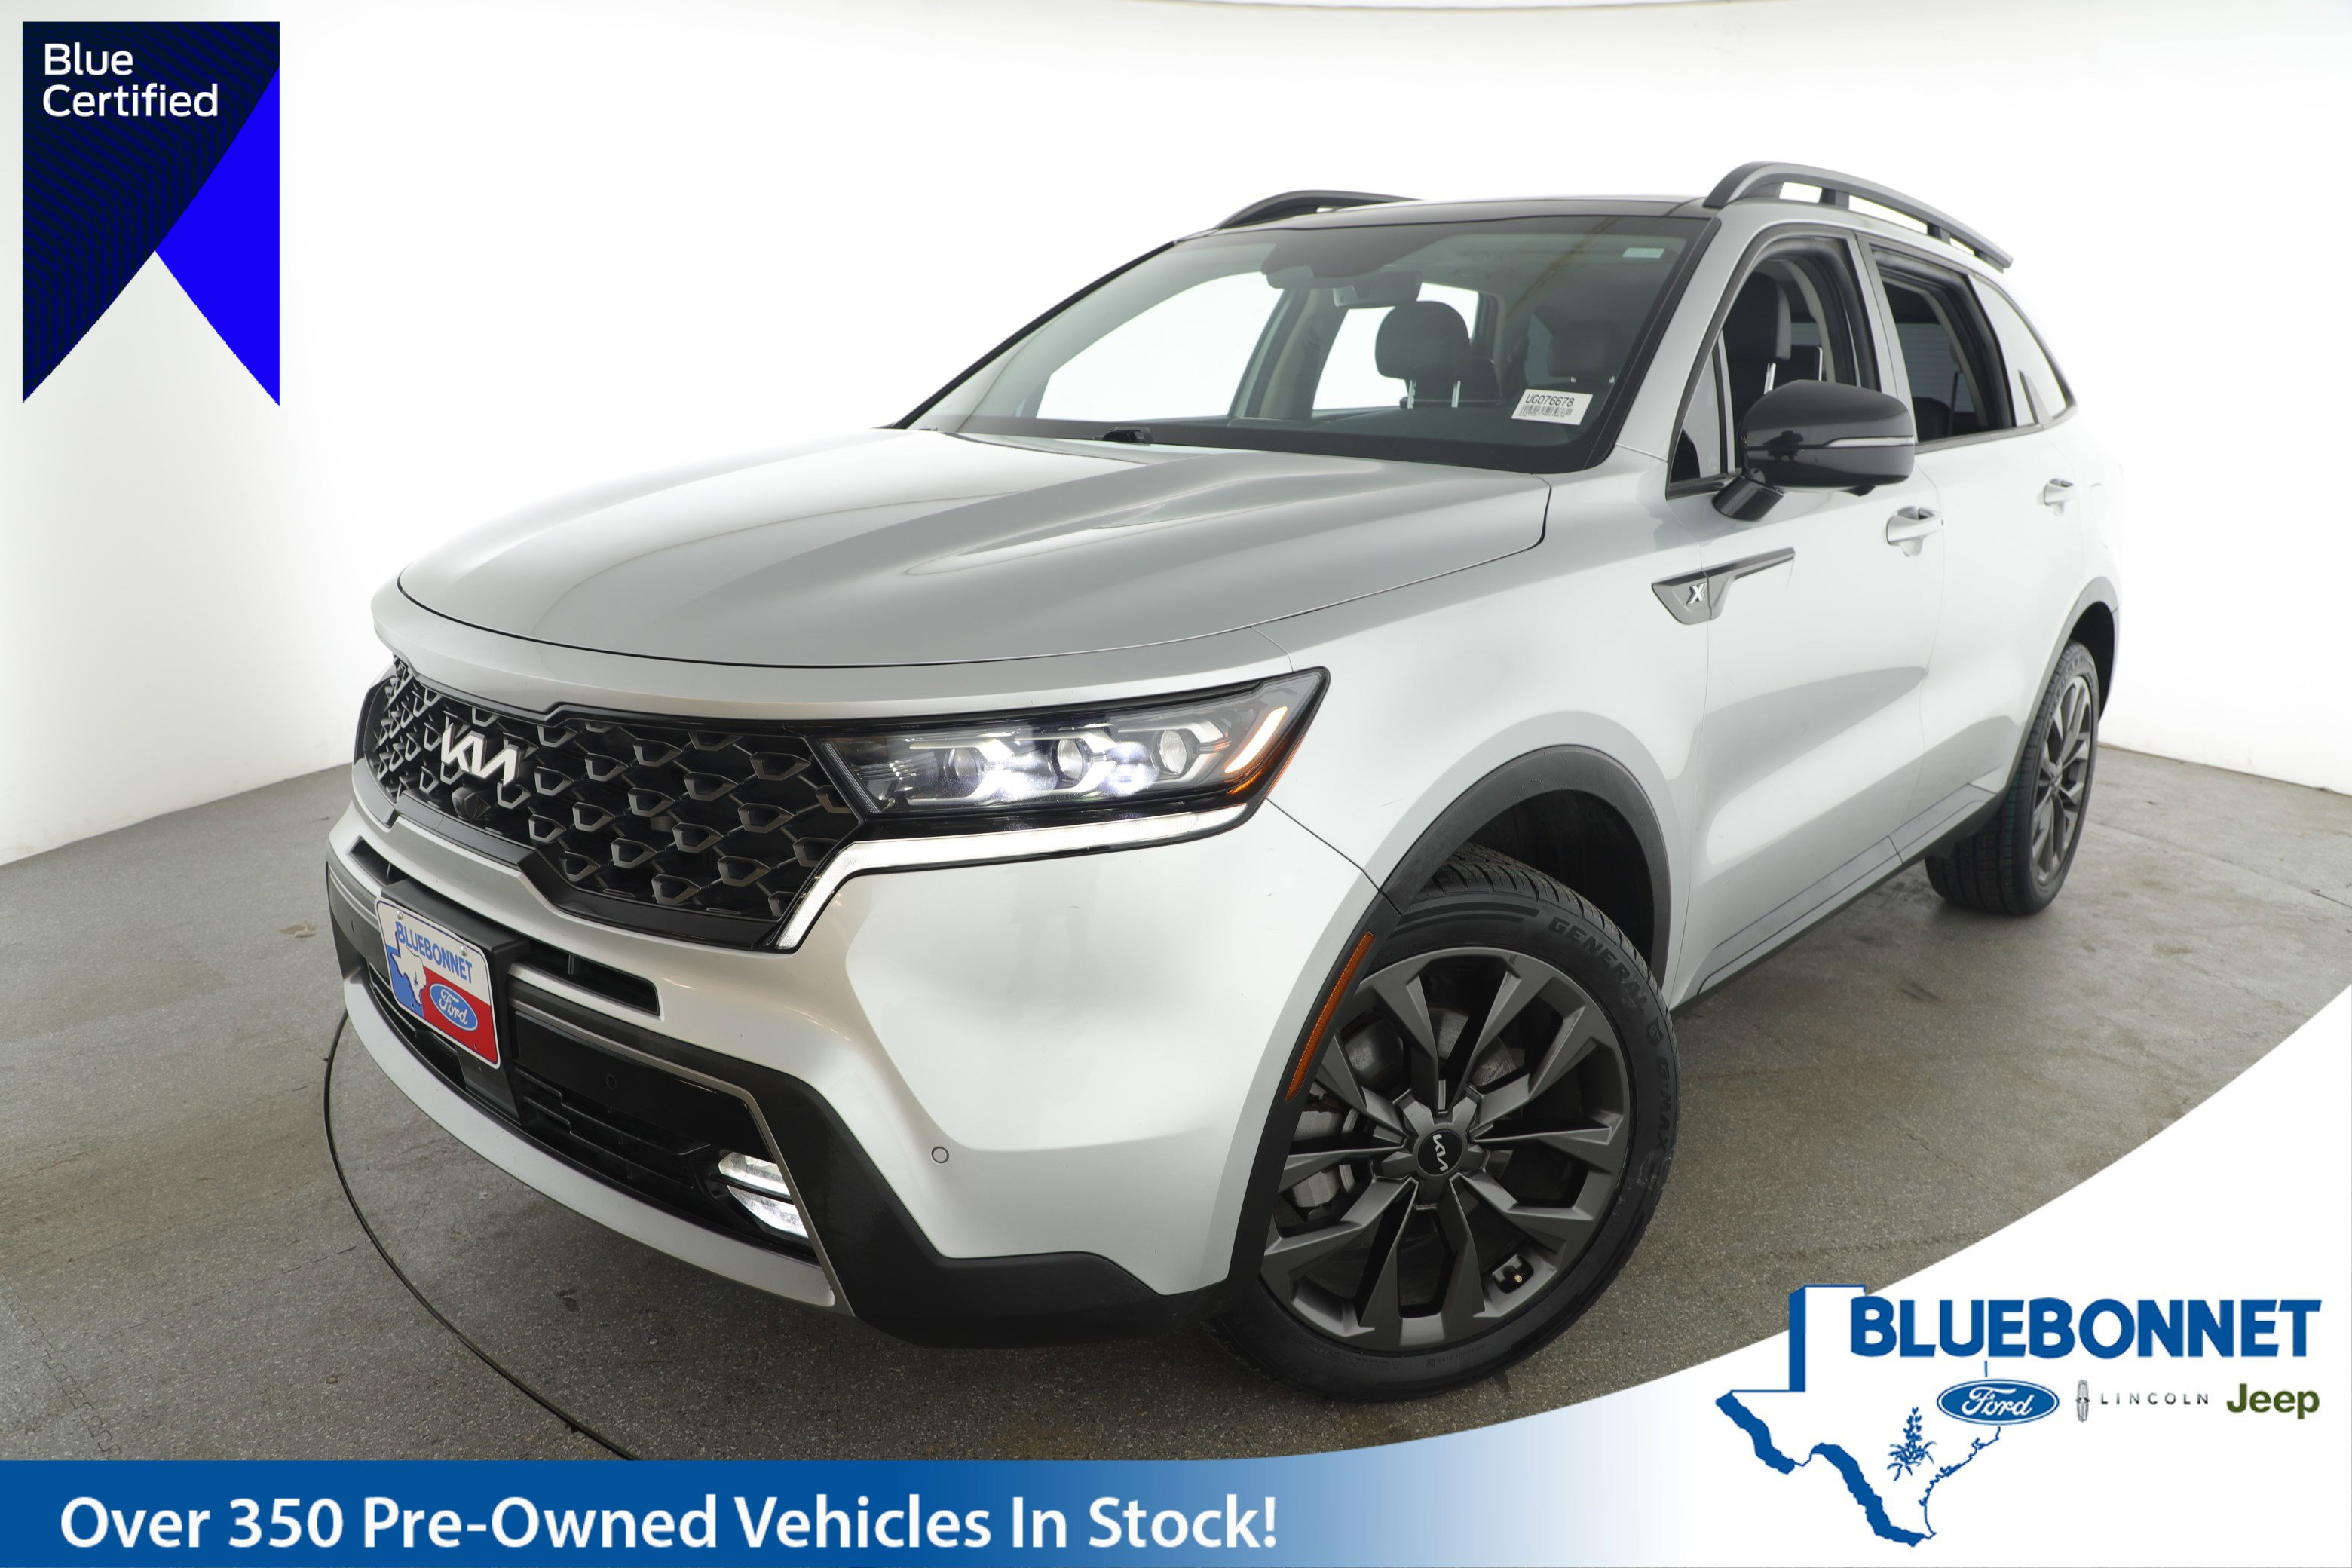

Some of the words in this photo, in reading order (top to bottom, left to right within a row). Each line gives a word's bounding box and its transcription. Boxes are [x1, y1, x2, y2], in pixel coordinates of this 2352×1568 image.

[441, 723, 521, 788] KIA
[395, 921, 473, 984] BLUEBONNET
[439, 989, 469, 1025] Ford
